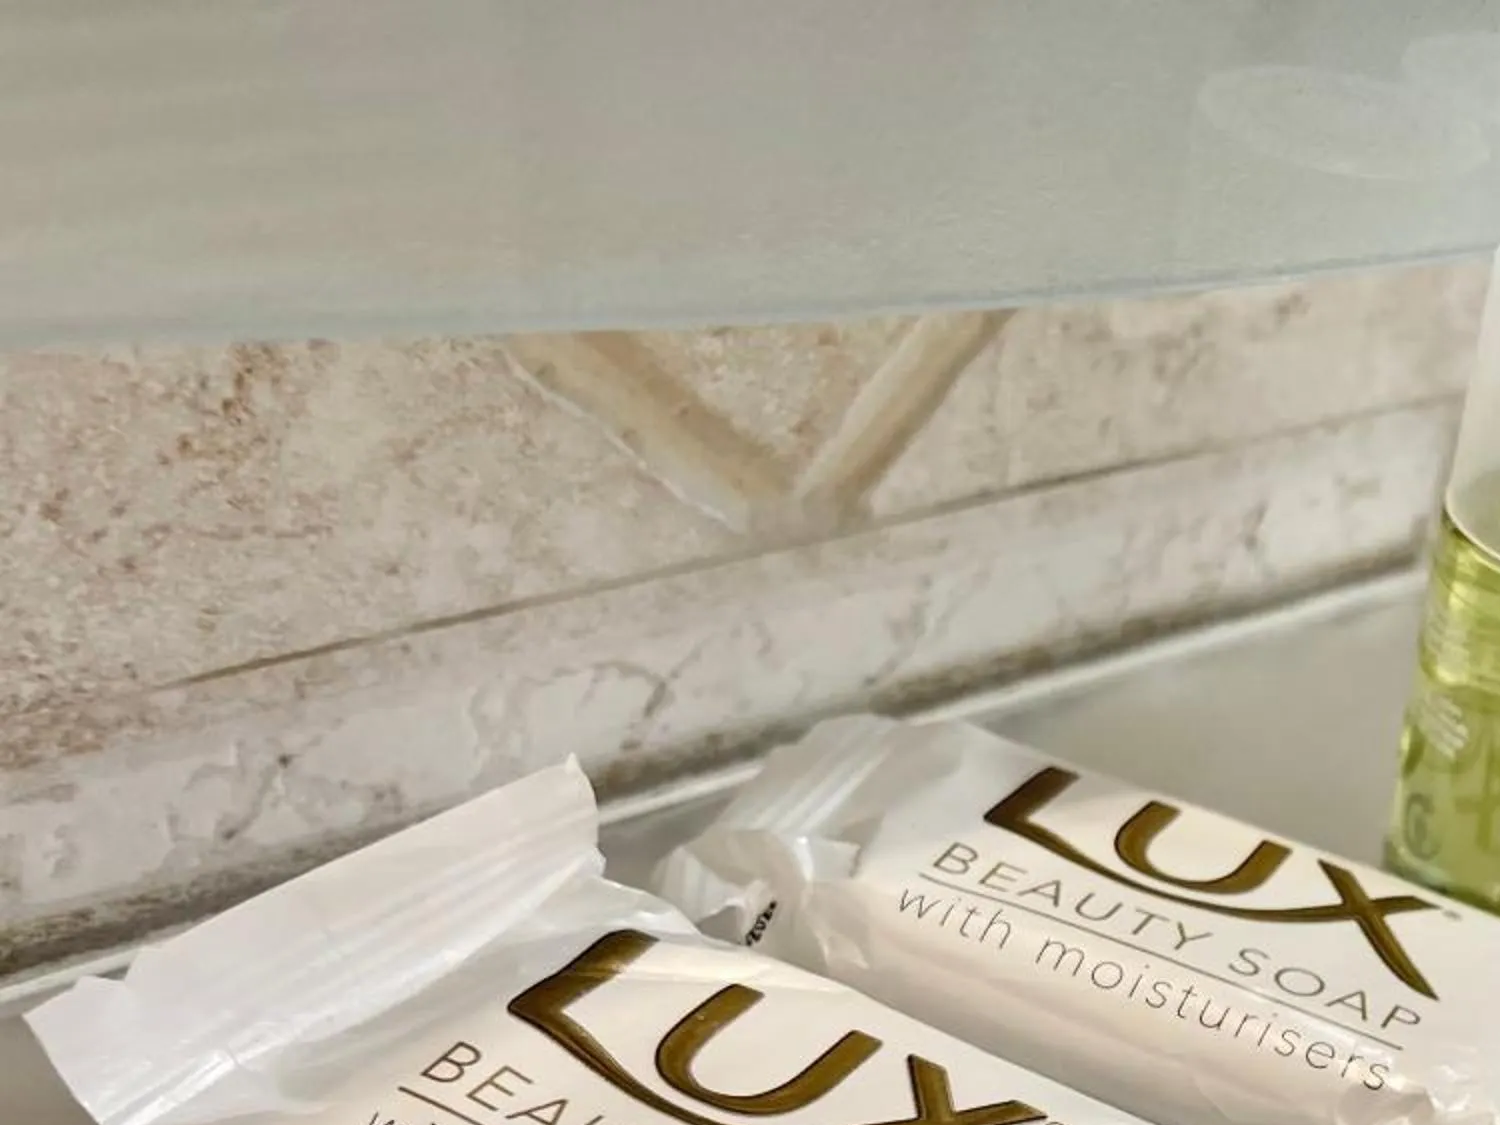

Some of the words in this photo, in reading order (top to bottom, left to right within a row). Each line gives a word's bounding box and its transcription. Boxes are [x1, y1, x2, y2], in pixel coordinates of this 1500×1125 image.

[931, 842, 1214, 952] BEAUTY
[1227, 947, 1422, 1031] SOAP
[984, 766, 1443, 1000] LUX
[898, 888, 1012, 950] with
[1034, 934, 1391, 1092] moisturisers
